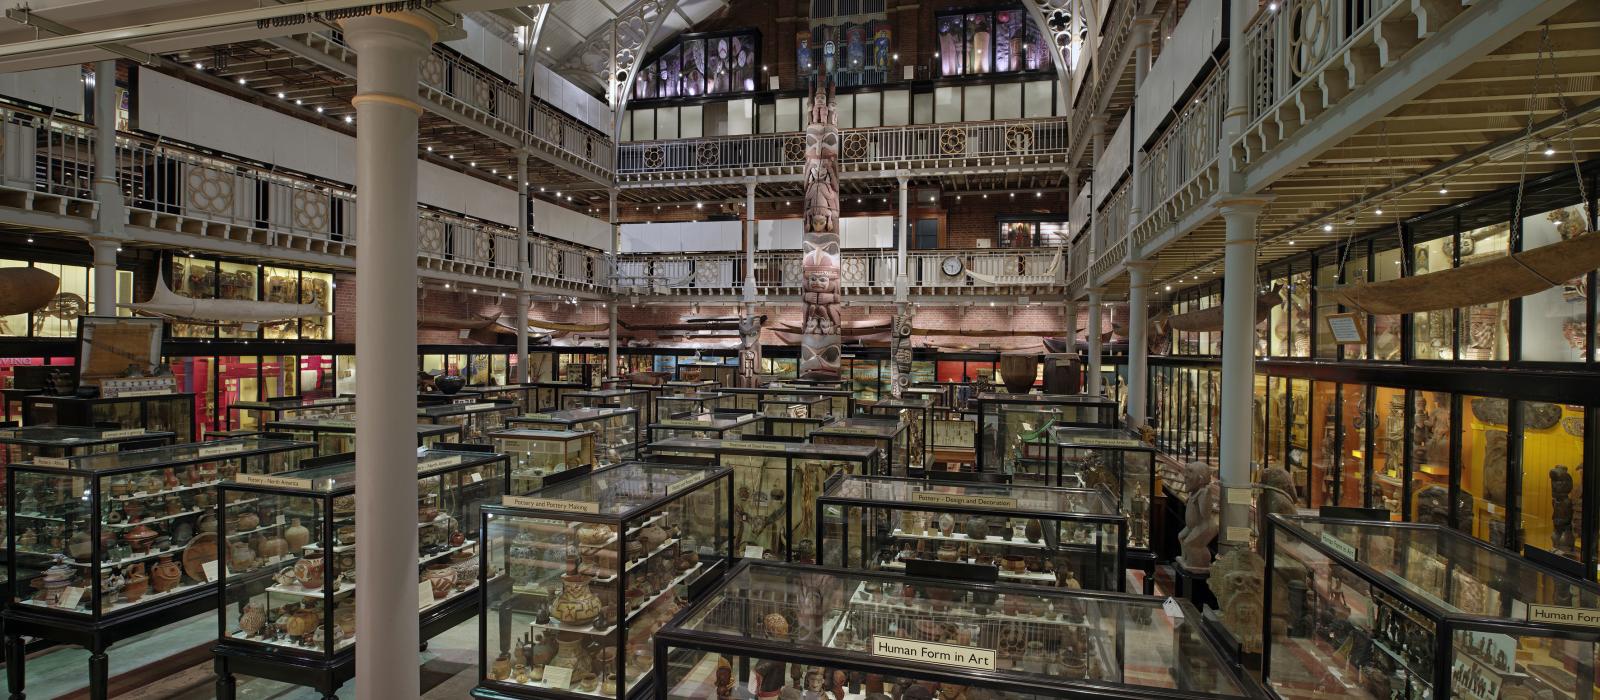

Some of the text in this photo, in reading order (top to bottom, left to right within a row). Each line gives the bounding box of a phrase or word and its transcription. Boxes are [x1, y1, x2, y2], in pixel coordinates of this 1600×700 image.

[247, 476, 263, 485] Pottery
[268, 477, 281, 486] North
[281, 478, 299, 487] America
[514, 499, 534, 508] Pottery
[546, 500, 567, 510] Pottery
[568, 502, 588, 512] Making
[918, 494, 939, 503] Pottery
[945, 496, 965, 505] Design
[978, 498, 1011, 506] Decoration
[1535, 608, 1574, 621] Human
[878, 641, 989, 665] Human Form in Art
